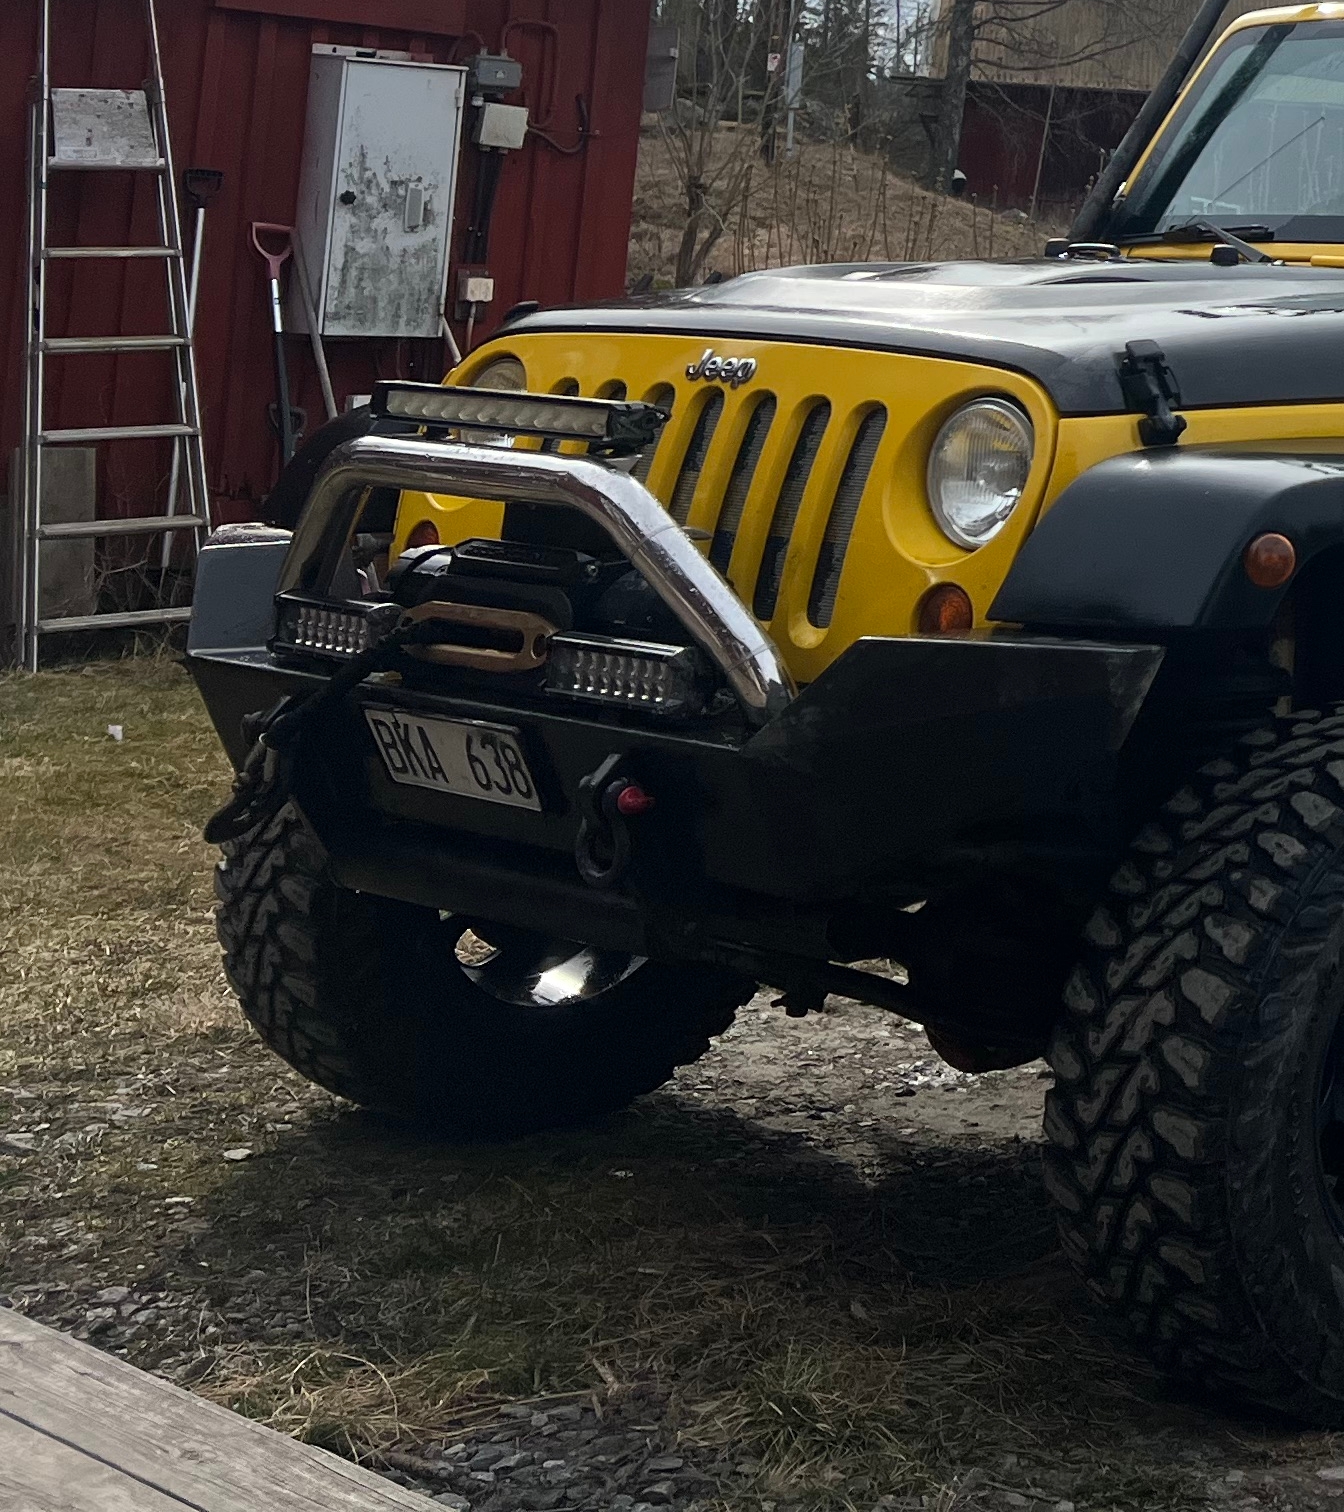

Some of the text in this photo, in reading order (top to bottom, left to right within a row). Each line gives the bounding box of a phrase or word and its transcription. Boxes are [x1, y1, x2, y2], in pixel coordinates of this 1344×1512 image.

[685, 348, 757, 390] Jeep
[371, 718, 532, 799] BKA 638
